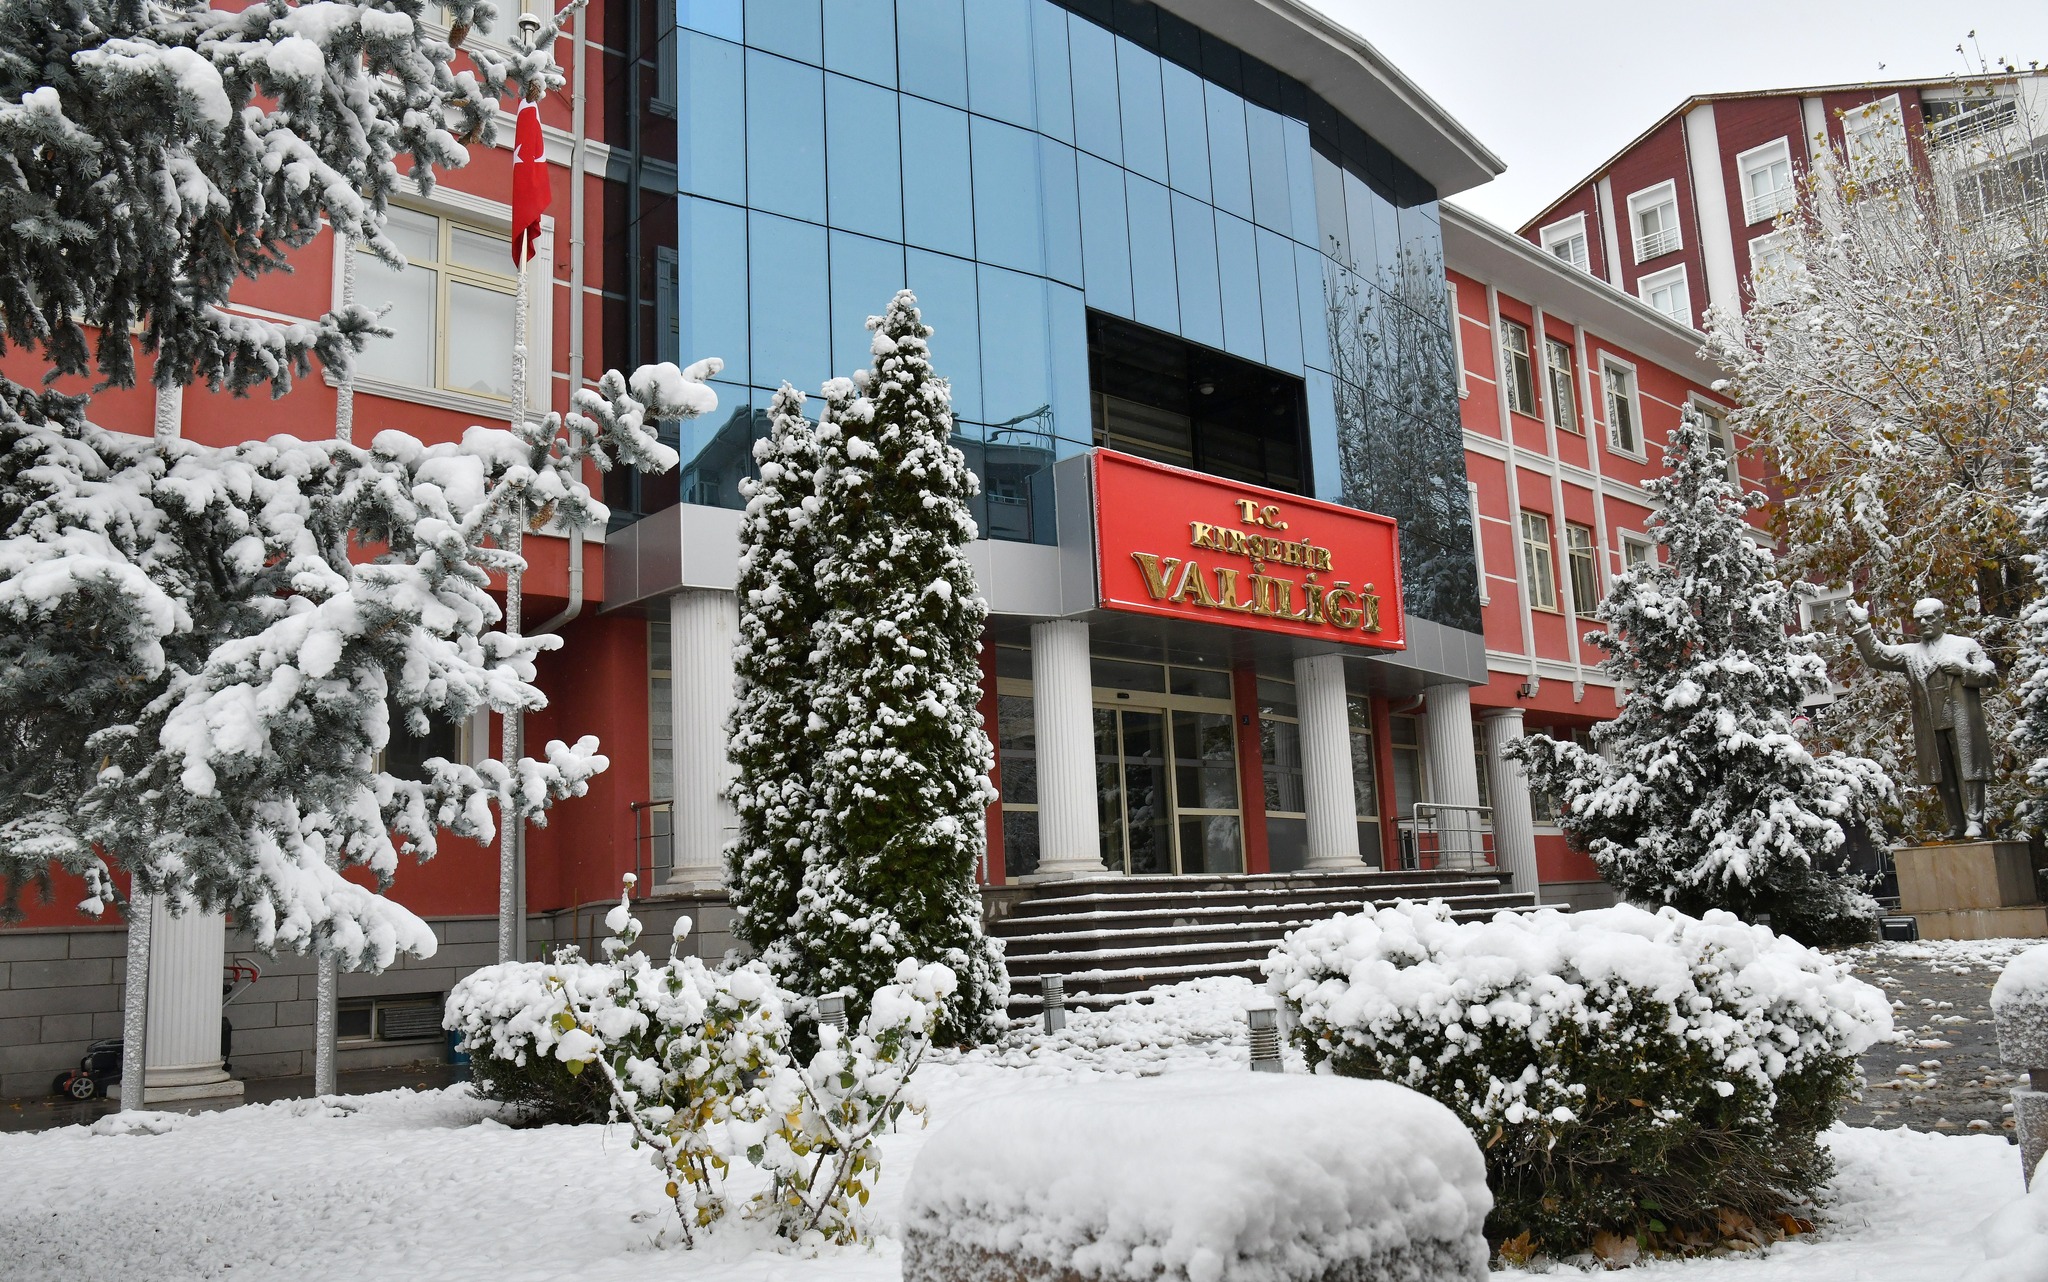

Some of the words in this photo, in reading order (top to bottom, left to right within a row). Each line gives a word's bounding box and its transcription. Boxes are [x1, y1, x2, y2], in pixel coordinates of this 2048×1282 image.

[1235, 499, 1289, 531] T.C.
[1189, 521, 1334, 571] KIRŞEHİR
[1130, 552, 1383, 633] VALİLİĞİ
